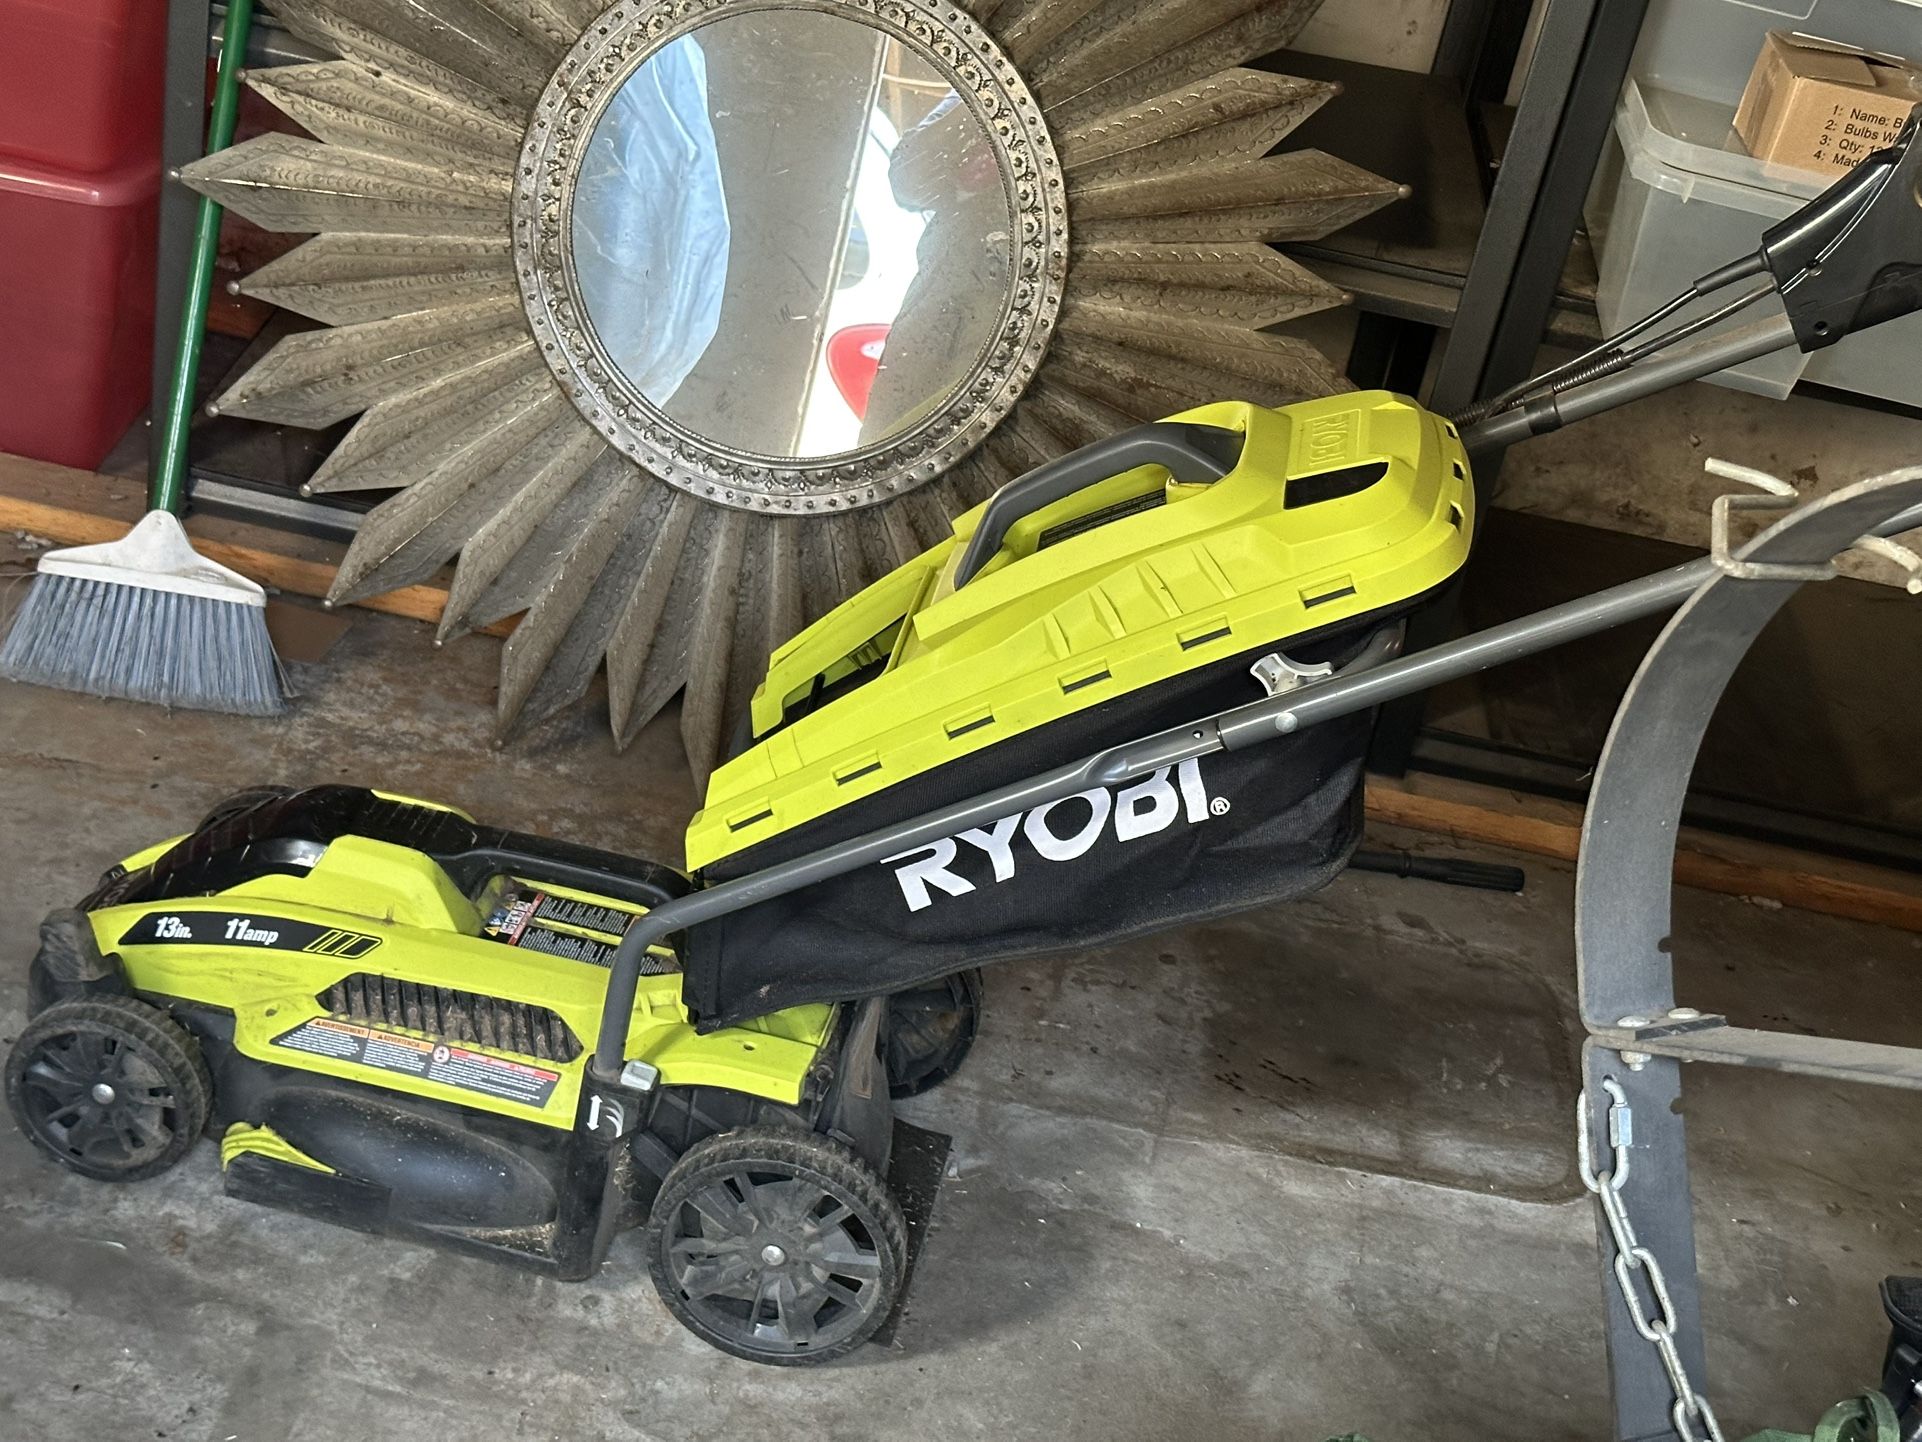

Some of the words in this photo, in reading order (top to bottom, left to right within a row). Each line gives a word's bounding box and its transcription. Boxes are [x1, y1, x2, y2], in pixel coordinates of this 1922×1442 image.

[1832, 104, 1843, 116] 1:
[1850, 108, 1890, 127] Name:
[1825, 119, 1837, 131] 2:
[1844, 123, 1879, 140] Bulbs
[1819, 134, 1832, 146] 3:
[1838, 138, 1864, 154] Qty:
[1813, 150, 1825, 161] 4:
[154, 916, 193, 939] 13in.
[224, 918, 279, 945] 11amp
